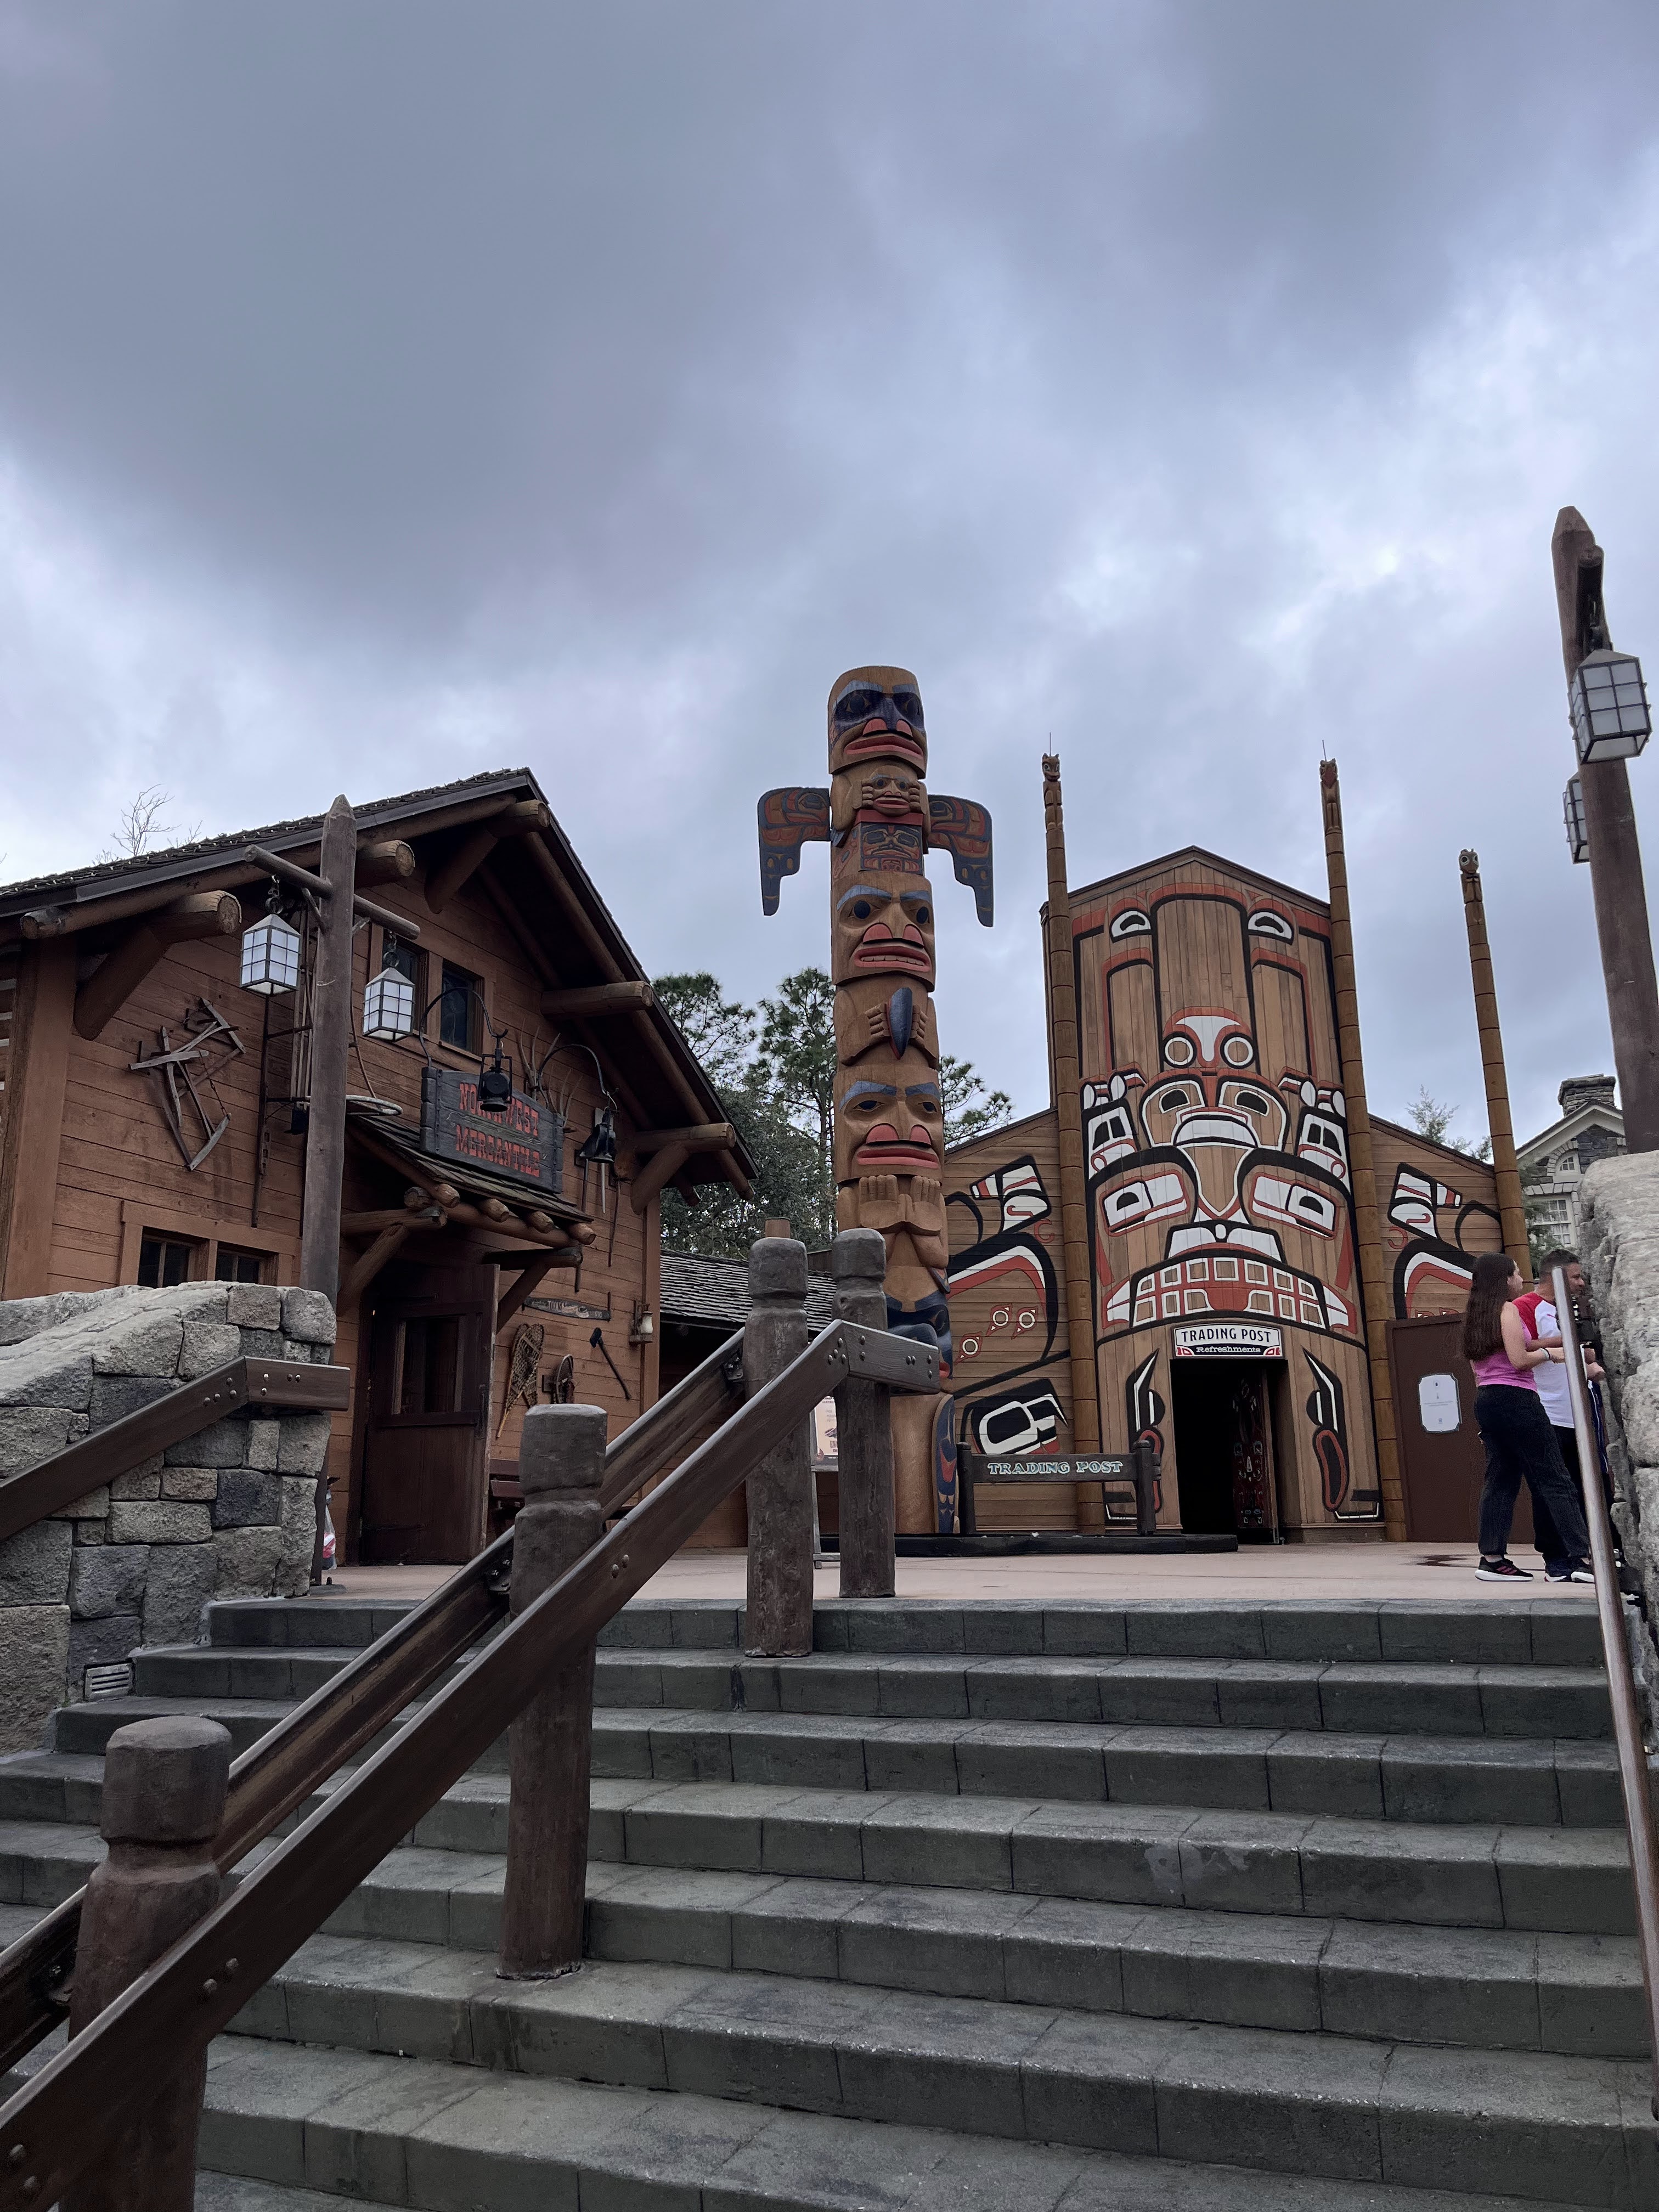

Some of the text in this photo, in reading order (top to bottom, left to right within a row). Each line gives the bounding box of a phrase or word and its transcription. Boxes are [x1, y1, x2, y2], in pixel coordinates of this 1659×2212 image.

[456, 1124, 540, 1178] MERCANTILE
[1181, 1328, 1271, 1342] TRADING POST
[987, 1460, 1124, 1475] TRADING POST
